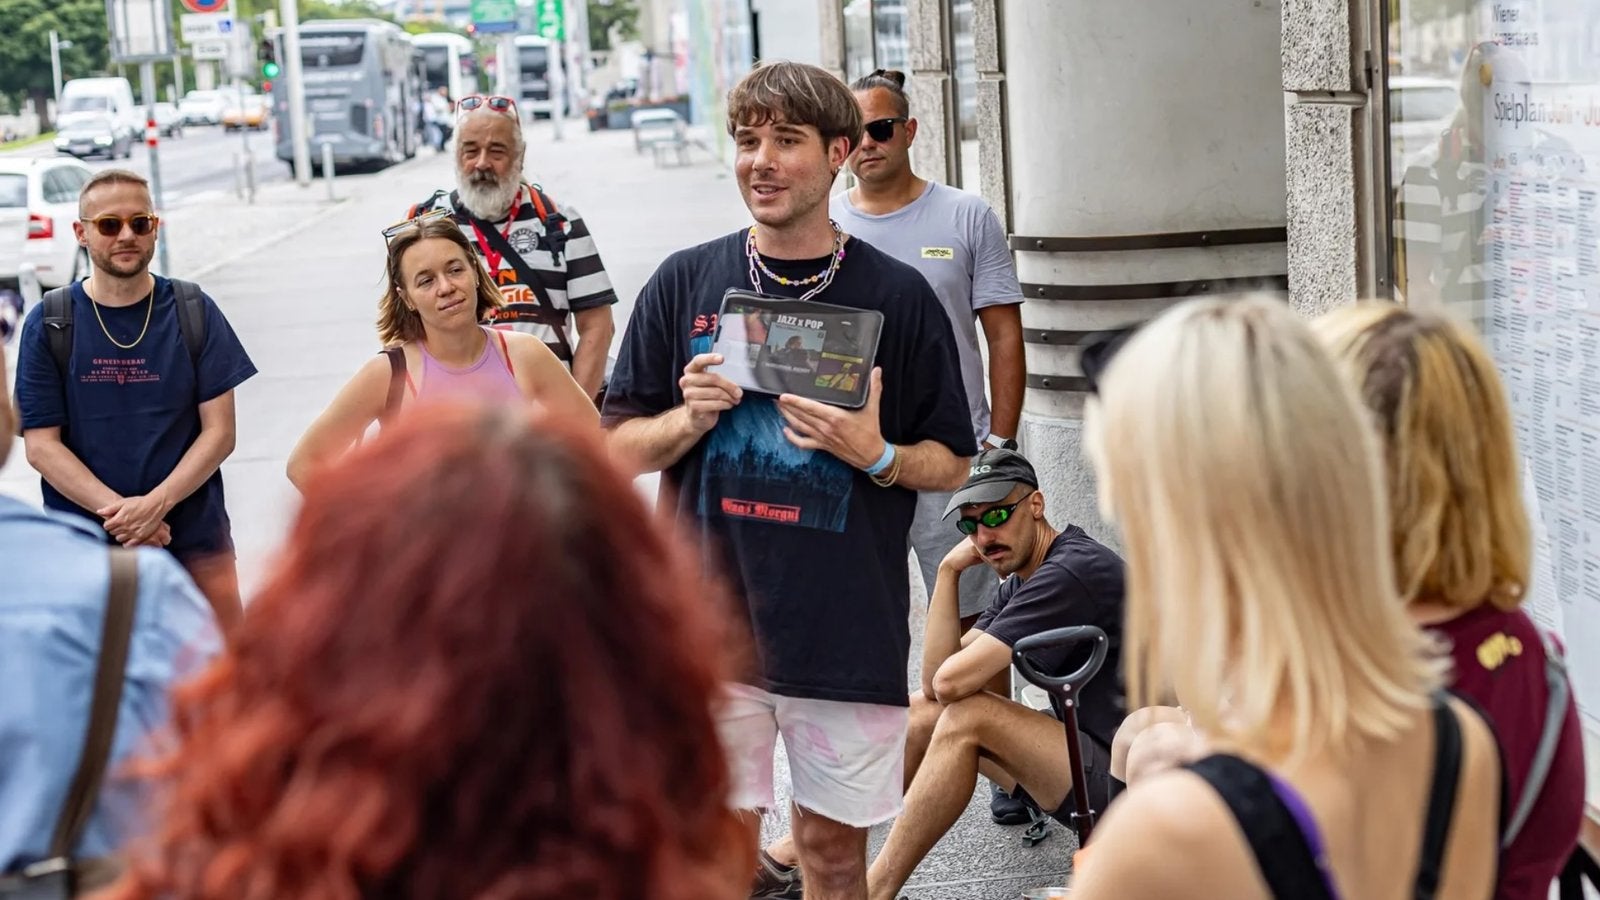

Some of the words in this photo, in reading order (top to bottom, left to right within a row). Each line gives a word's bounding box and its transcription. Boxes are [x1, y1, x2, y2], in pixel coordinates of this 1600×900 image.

[1494, 92, 1546, 129] Spielplan
[501, 287, 535, 303] GIE
[777, 314, 797, 326] JAZZ
[804, 319, 824, 330] POP
